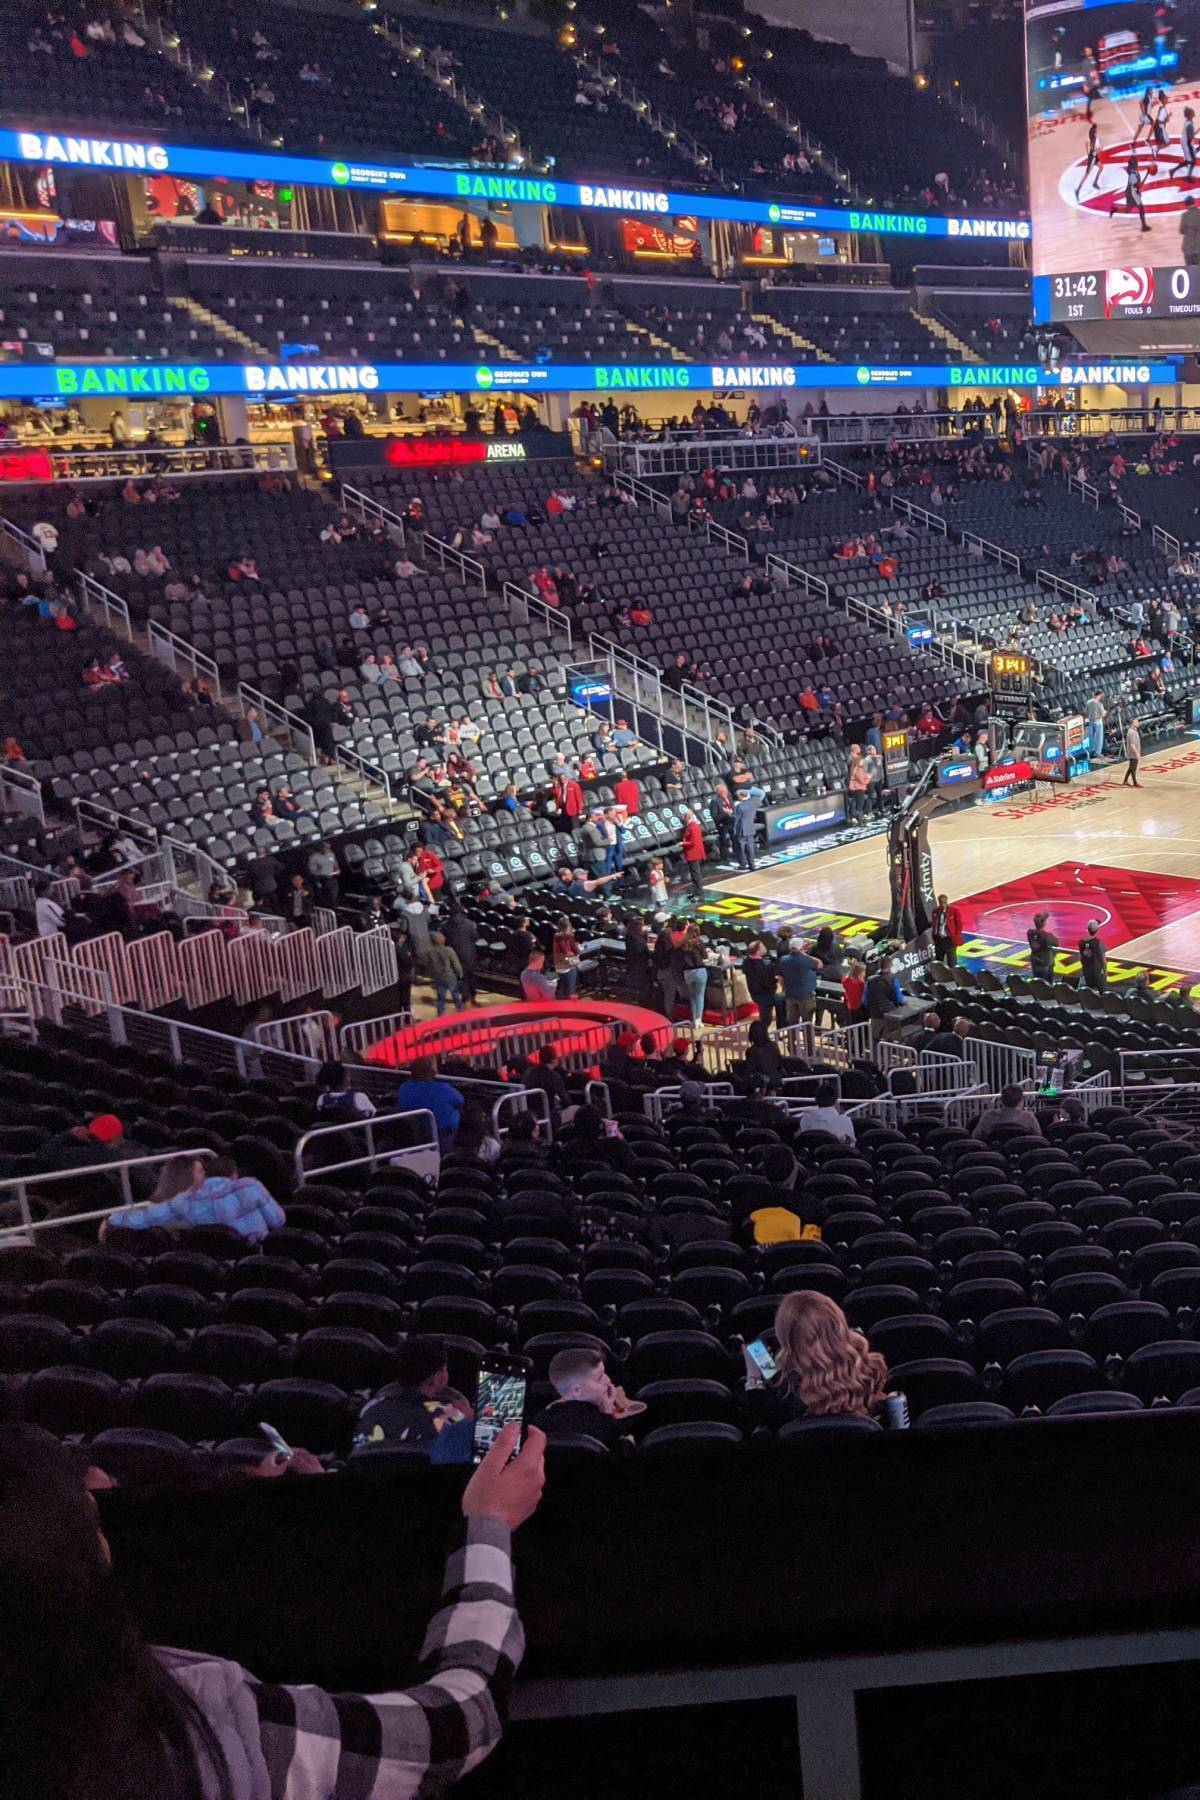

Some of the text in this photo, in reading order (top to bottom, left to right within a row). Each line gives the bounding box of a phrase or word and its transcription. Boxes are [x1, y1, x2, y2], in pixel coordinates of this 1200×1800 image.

[20, 133, 169, 170] BANKING
[389, 171, 406, 180] OWN
[456, 174, 556, 202] BANKING
[580, 185, 670, 212] BANKING
[850, 212, 927, 234] BANKING
[948, 218, 1029, 238] BANKING
[1055, 275, 1097, 298] 31:42
[1171, 269, 1190, 299] 0
[1068, 305, 1084, 317] 1ST
[1124, 307, 1143, 315] FOULS
[1169, 305, 1200, 313] TIMEOUTS
[56, 368, 210, 394] BANKING
[246, 366, 380, 391] BANKING
[595, 367, 690, 388] BANKING
[712, 366, 796, 387] BANKING
[951, 367, 1038, 385] BANKING
[1060, 366, 1151, 385] BANKING
[487, 442, 527, 459] ARENA
[996, 657, 1026, 673] 31:41
[993, 771, 1016, 785] StateFarm
[991, 780, 1121, 821] StateFarm
[1065, 796, 1108, 811] ARENA
[920, 851, 933, 903] xfinity
